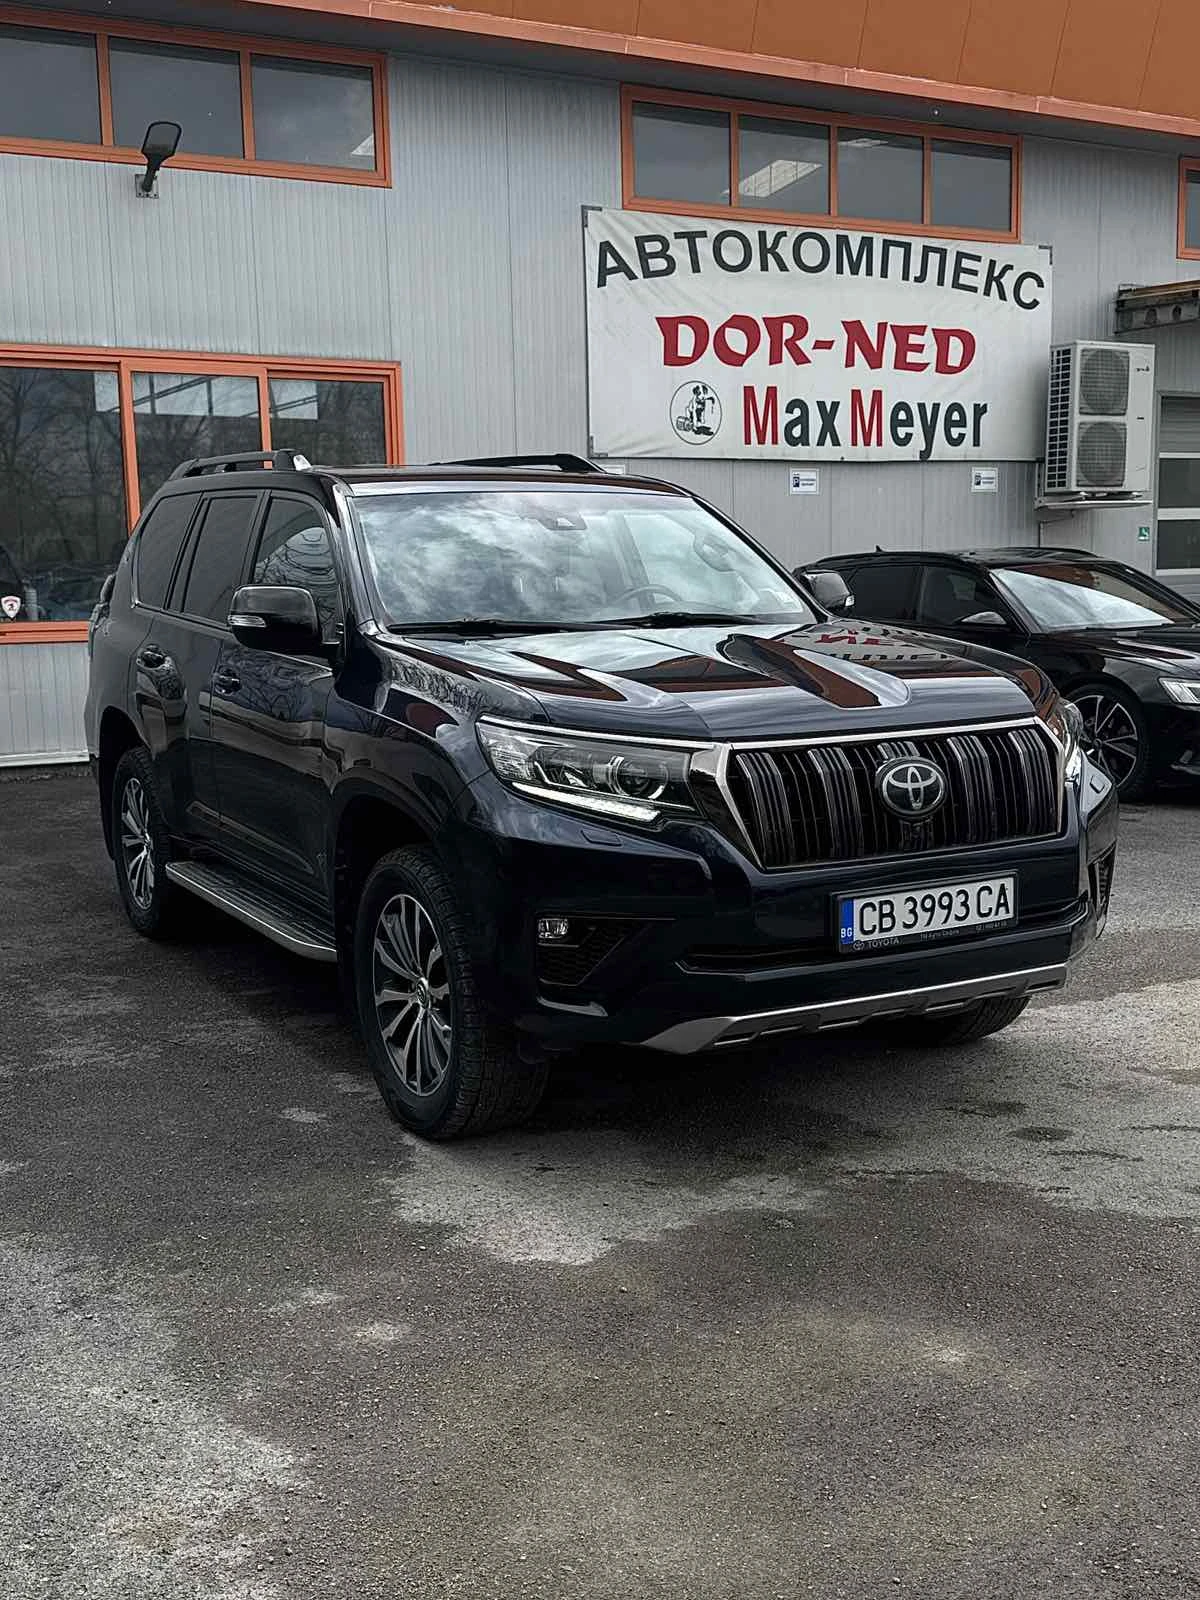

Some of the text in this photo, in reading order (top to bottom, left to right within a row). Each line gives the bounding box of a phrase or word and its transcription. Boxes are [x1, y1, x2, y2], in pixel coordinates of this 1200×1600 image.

[596, 228, 1045, 311] АВТОКОМПЛЕКС
[655, 314, 977, 376] DOR-NED
[743, 385, 988, 461] MaxMeyer
[840, 927, 853, 937] BG
[859, 883, 1010, 935] CB 3993 CA
[868, 937, 899, 949] TOYOTA
